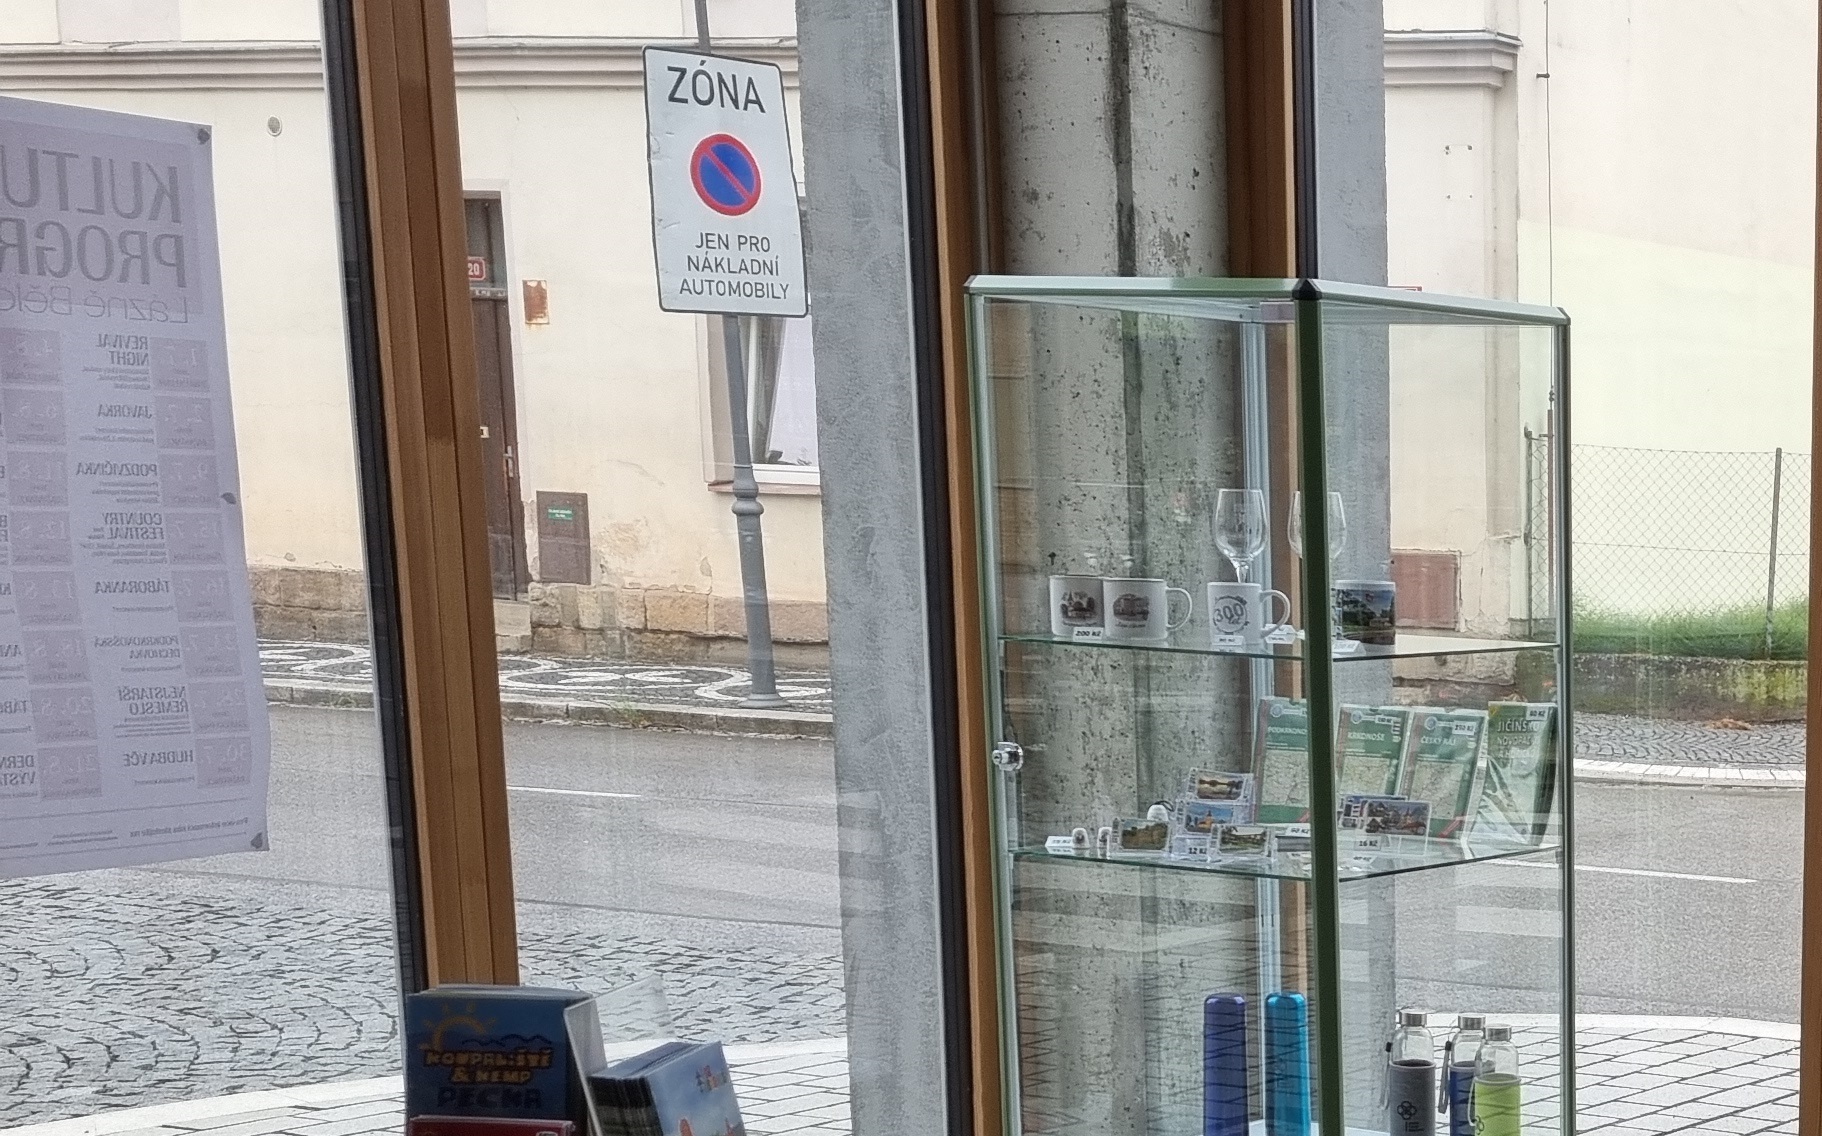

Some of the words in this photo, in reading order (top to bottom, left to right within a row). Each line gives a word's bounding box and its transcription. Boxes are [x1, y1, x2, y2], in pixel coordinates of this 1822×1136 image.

[666, 60, 766, 113] ZÓNA
[695, 232, 729, 250] JEN
[737, 234, 771, 252] PRO
[687, 251, 779, 276] NÁKLADNÍ
[680, 278, 789, 299] AUTOMOBILY
[1215, 603, 1244, 624] 300
